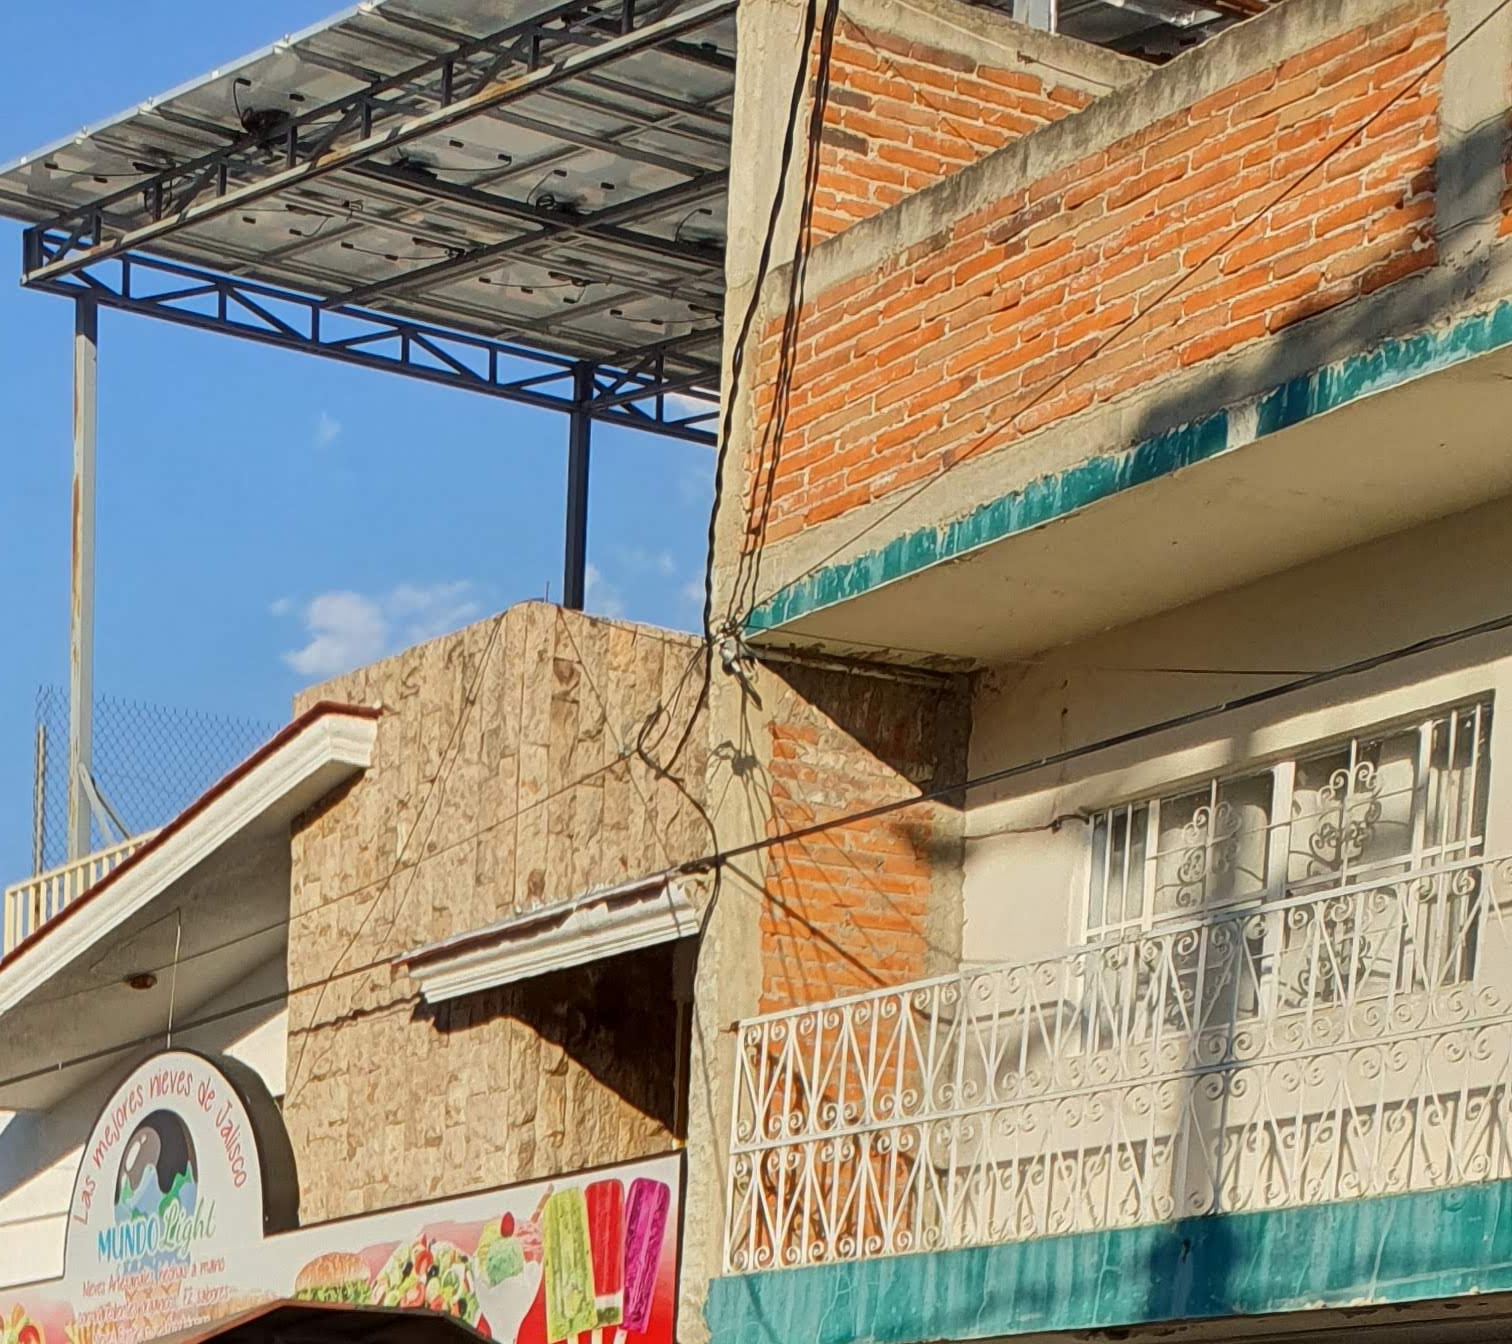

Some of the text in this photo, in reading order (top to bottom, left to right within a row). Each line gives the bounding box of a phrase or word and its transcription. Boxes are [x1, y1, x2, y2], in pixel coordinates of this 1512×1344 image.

[73, 1068, 247, 1225] Las mejores nieves de Jalisco
[98, 1197, 216, 1261] MUNDO Light
